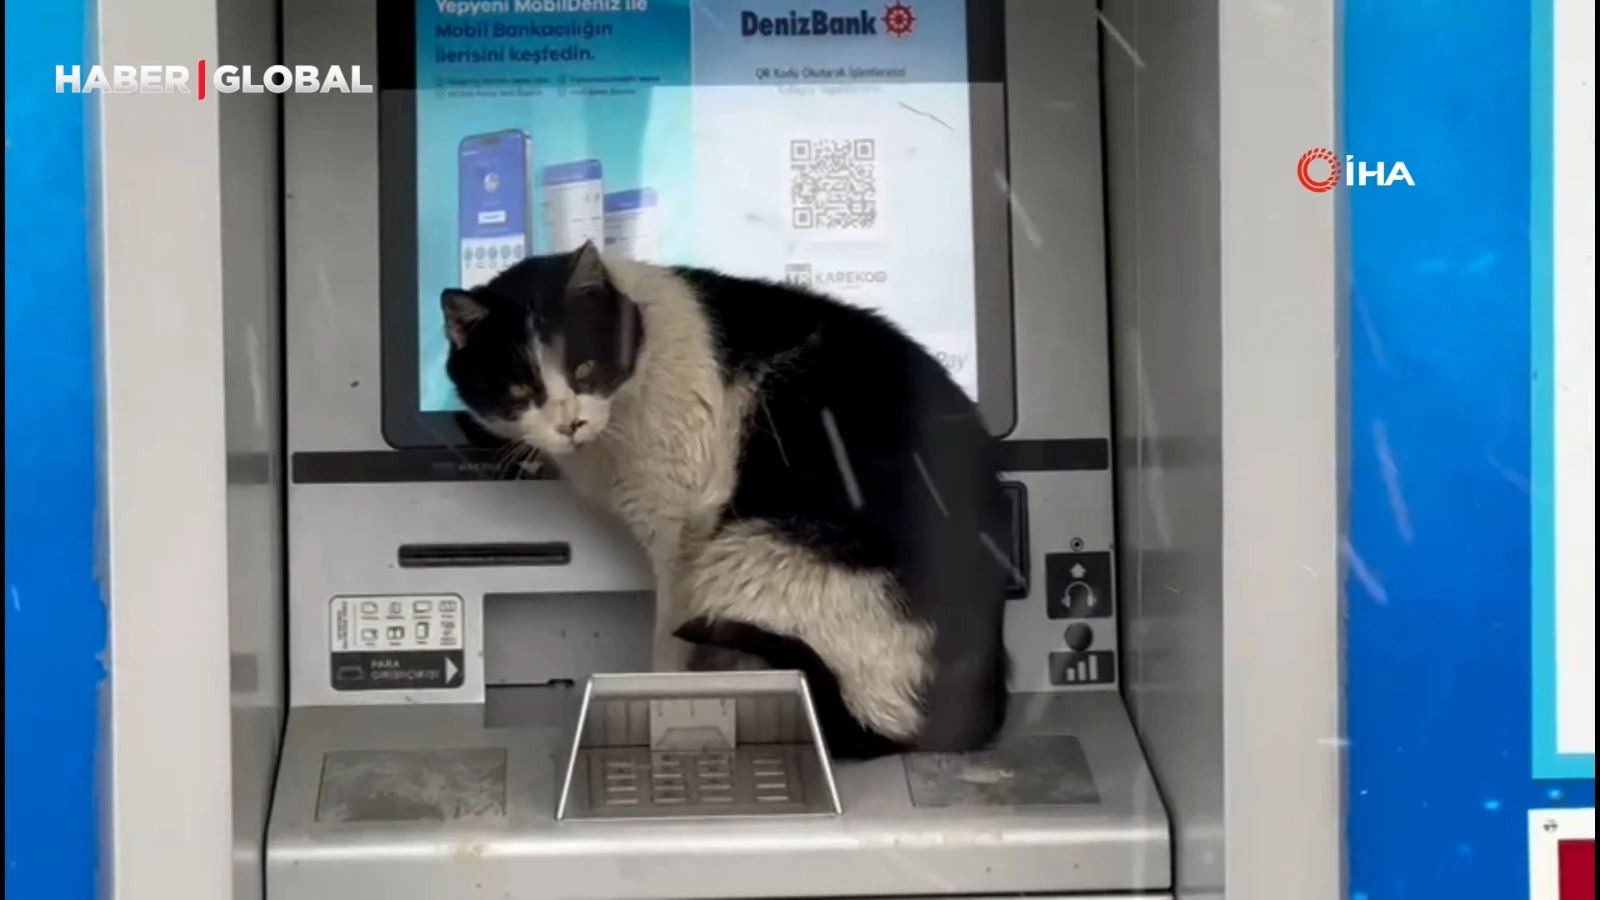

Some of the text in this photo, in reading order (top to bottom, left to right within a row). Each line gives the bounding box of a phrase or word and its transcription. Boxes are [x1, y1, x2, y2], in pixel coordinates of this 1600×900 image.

[436, 0, 509, 15] Yepyeni
[435, 20, 613, 40] Mobil Bankacılığın
[741, 9, 877, 37] DenizBank
[510, 45, 596, 64] keşfedin.
[755, 67, 771, 80] QR
[370, 659, 400, 669] PARA
